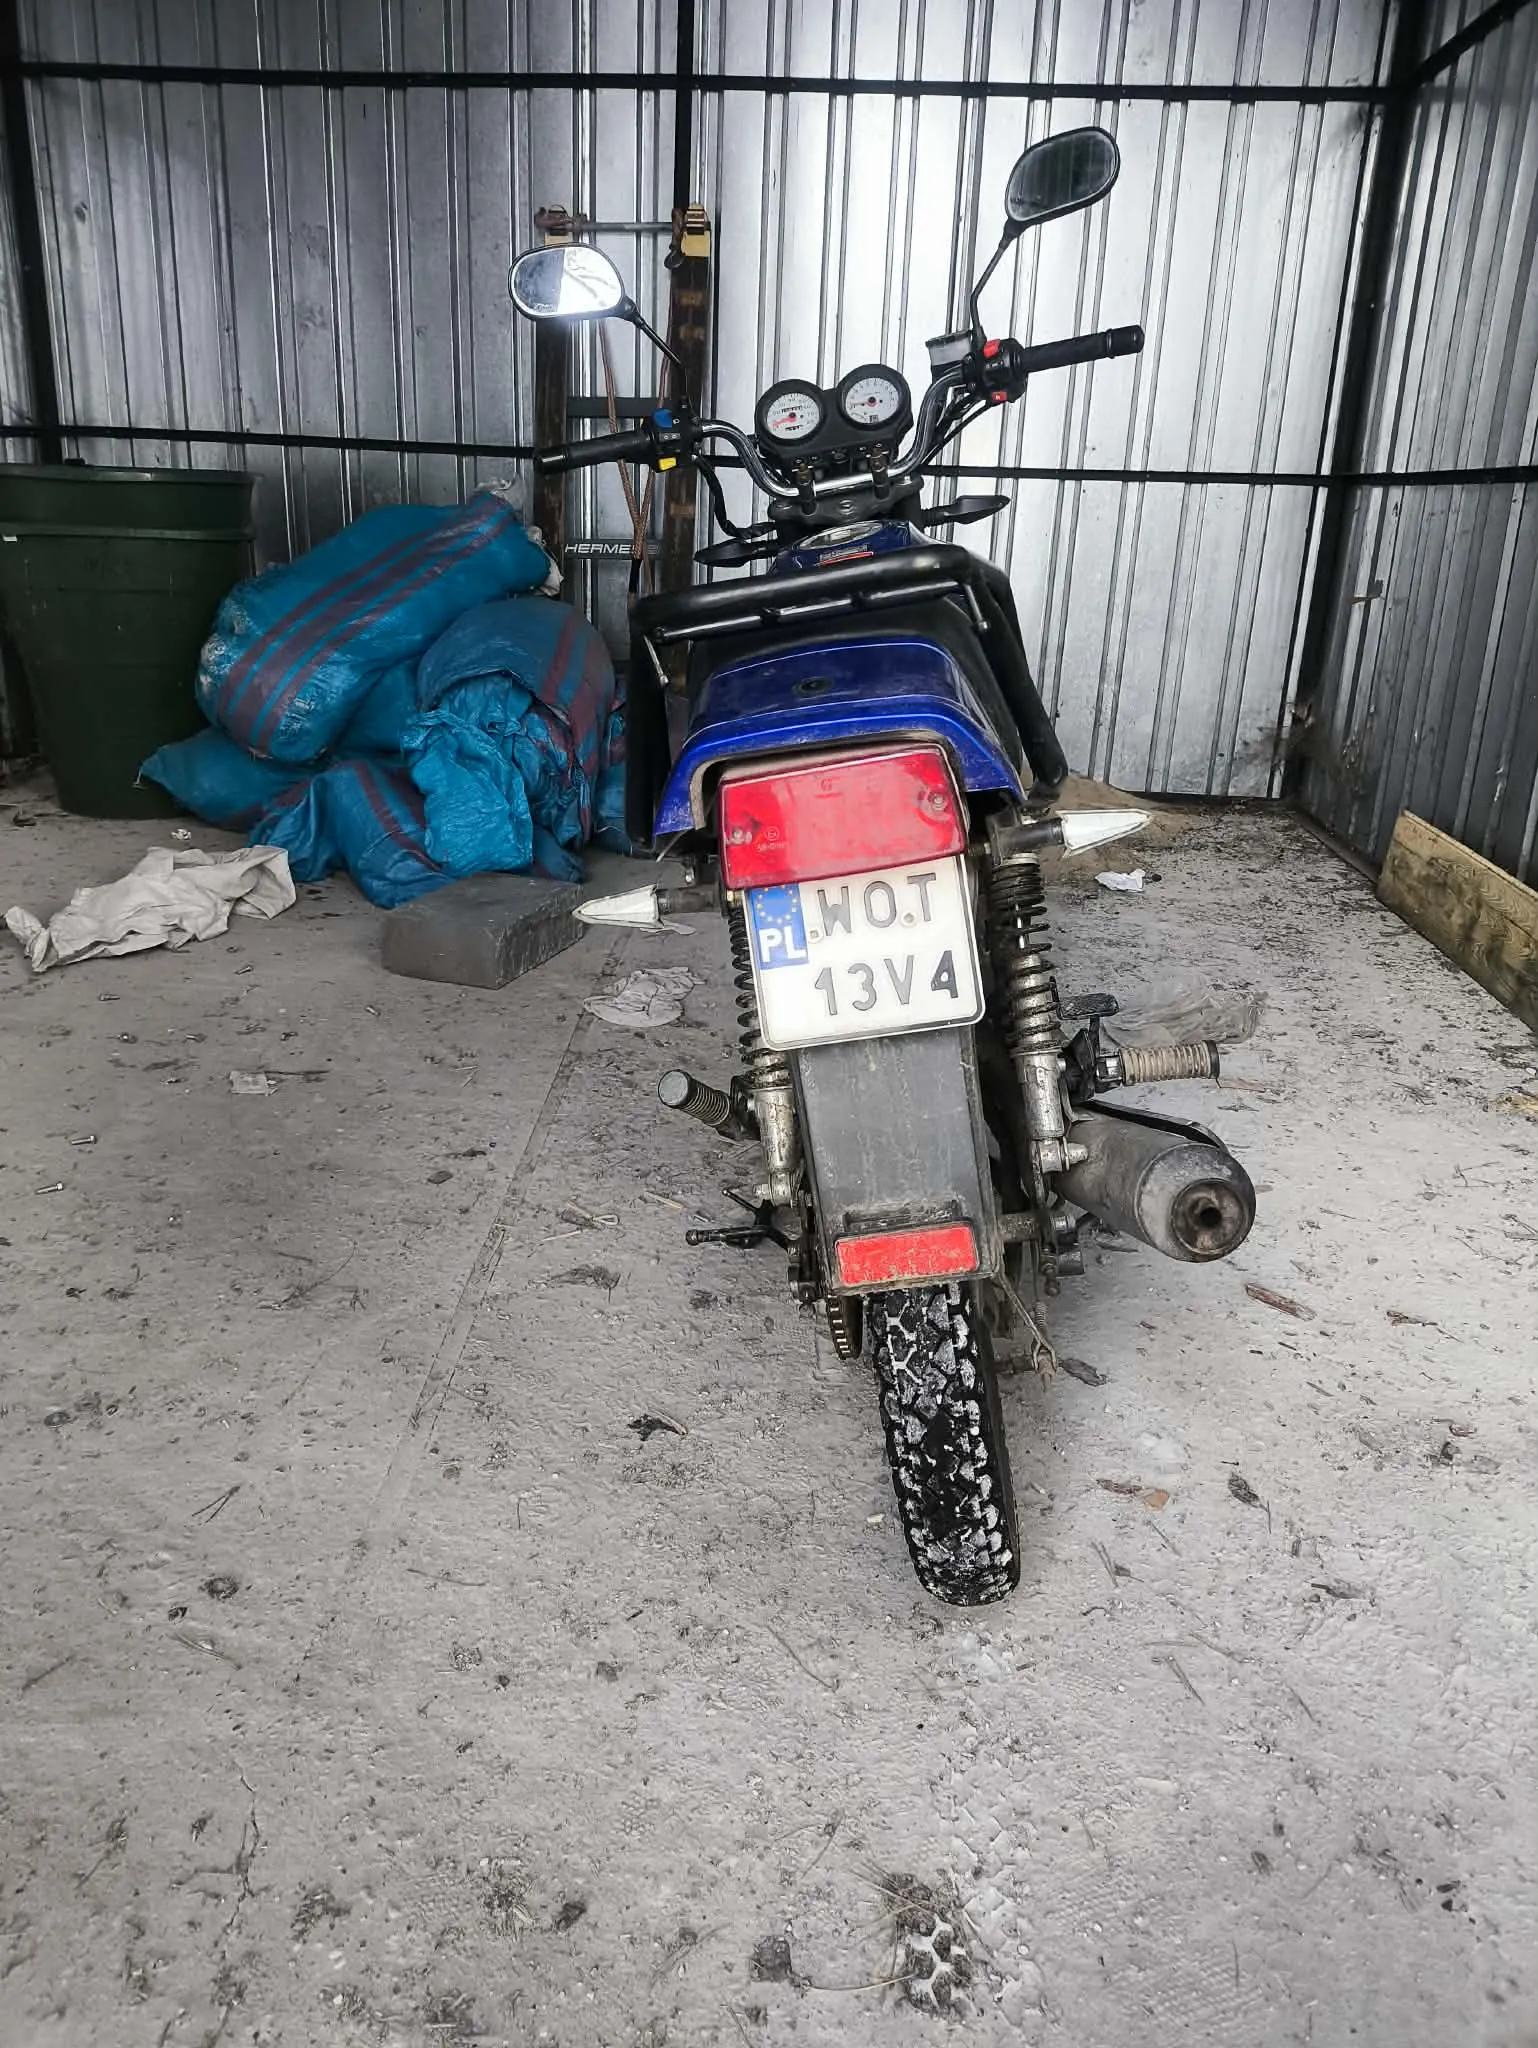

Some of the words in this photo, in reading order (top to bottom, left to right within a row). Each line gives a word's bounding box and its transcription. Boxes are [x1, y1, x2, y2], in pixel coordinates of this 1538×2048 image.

[564, 543, 639, 554] HERME
[817, 872, 937, 937] WOT
[759, 926, 806, 963] PL
[814, 950, 959, 1016] 13V4
